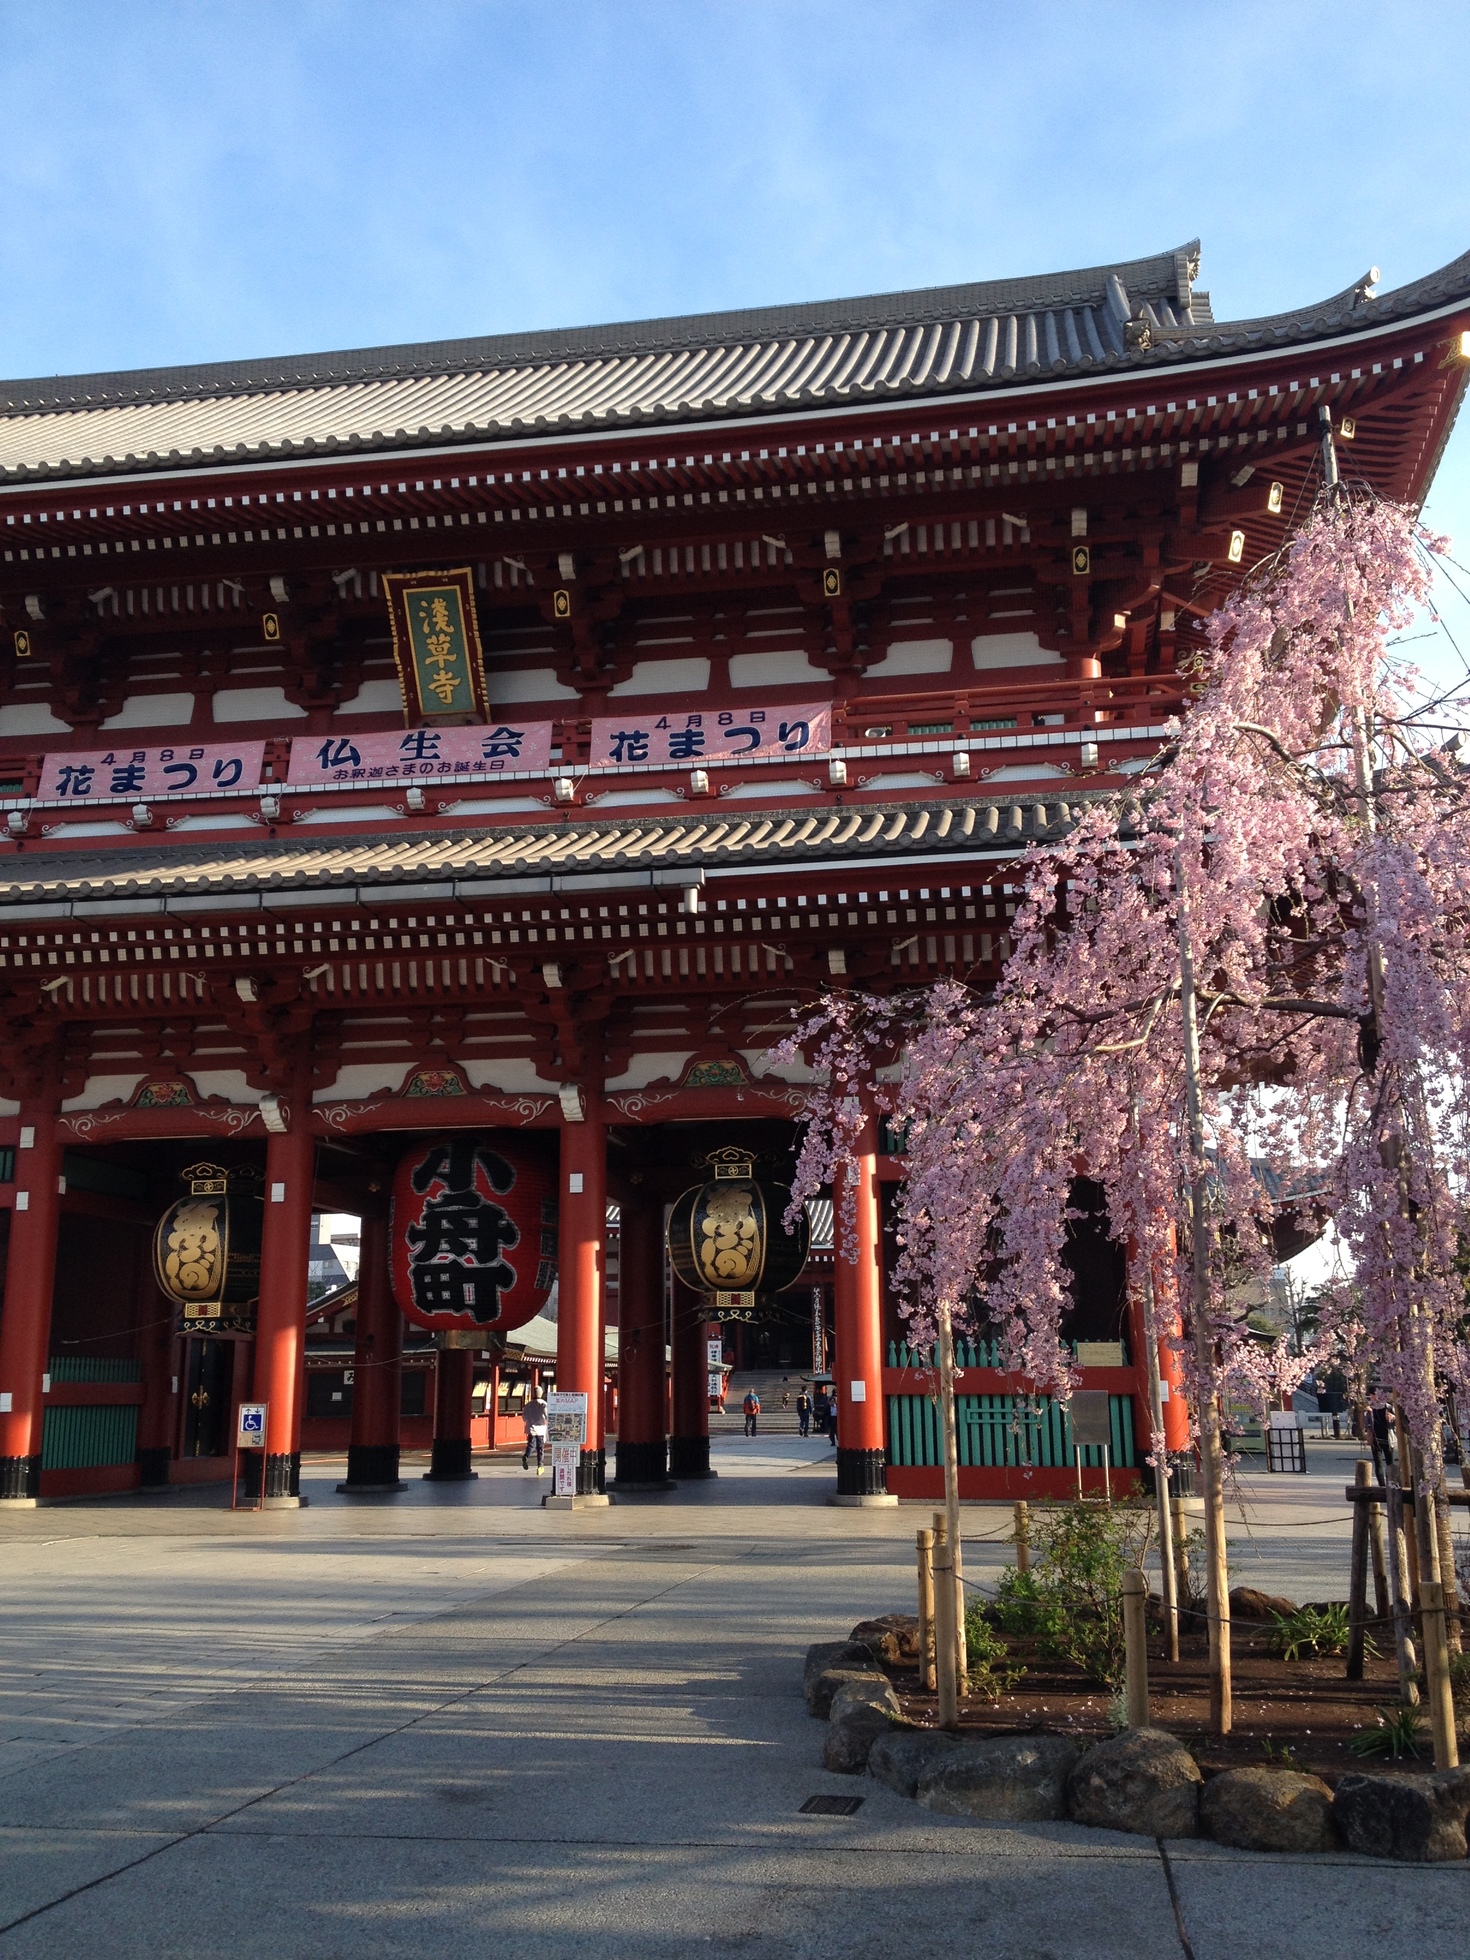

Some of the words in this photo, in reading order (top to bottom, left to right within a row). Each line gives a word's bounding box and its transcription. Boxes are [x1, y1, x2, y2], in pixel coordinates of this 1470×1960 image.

[655, 711, 766, 730] 4月8日
[101, 748, 205, 766] 4月8日
[316, 727, 525, 769] 仏生会
[609, 720, 810, 762] 花まつり
[55, 758, 243, 796] 花まつり
[333, 760, 505, 780] お釈迦さまのお誕生日
[406, 1138, 521, 1325] 小舟町
